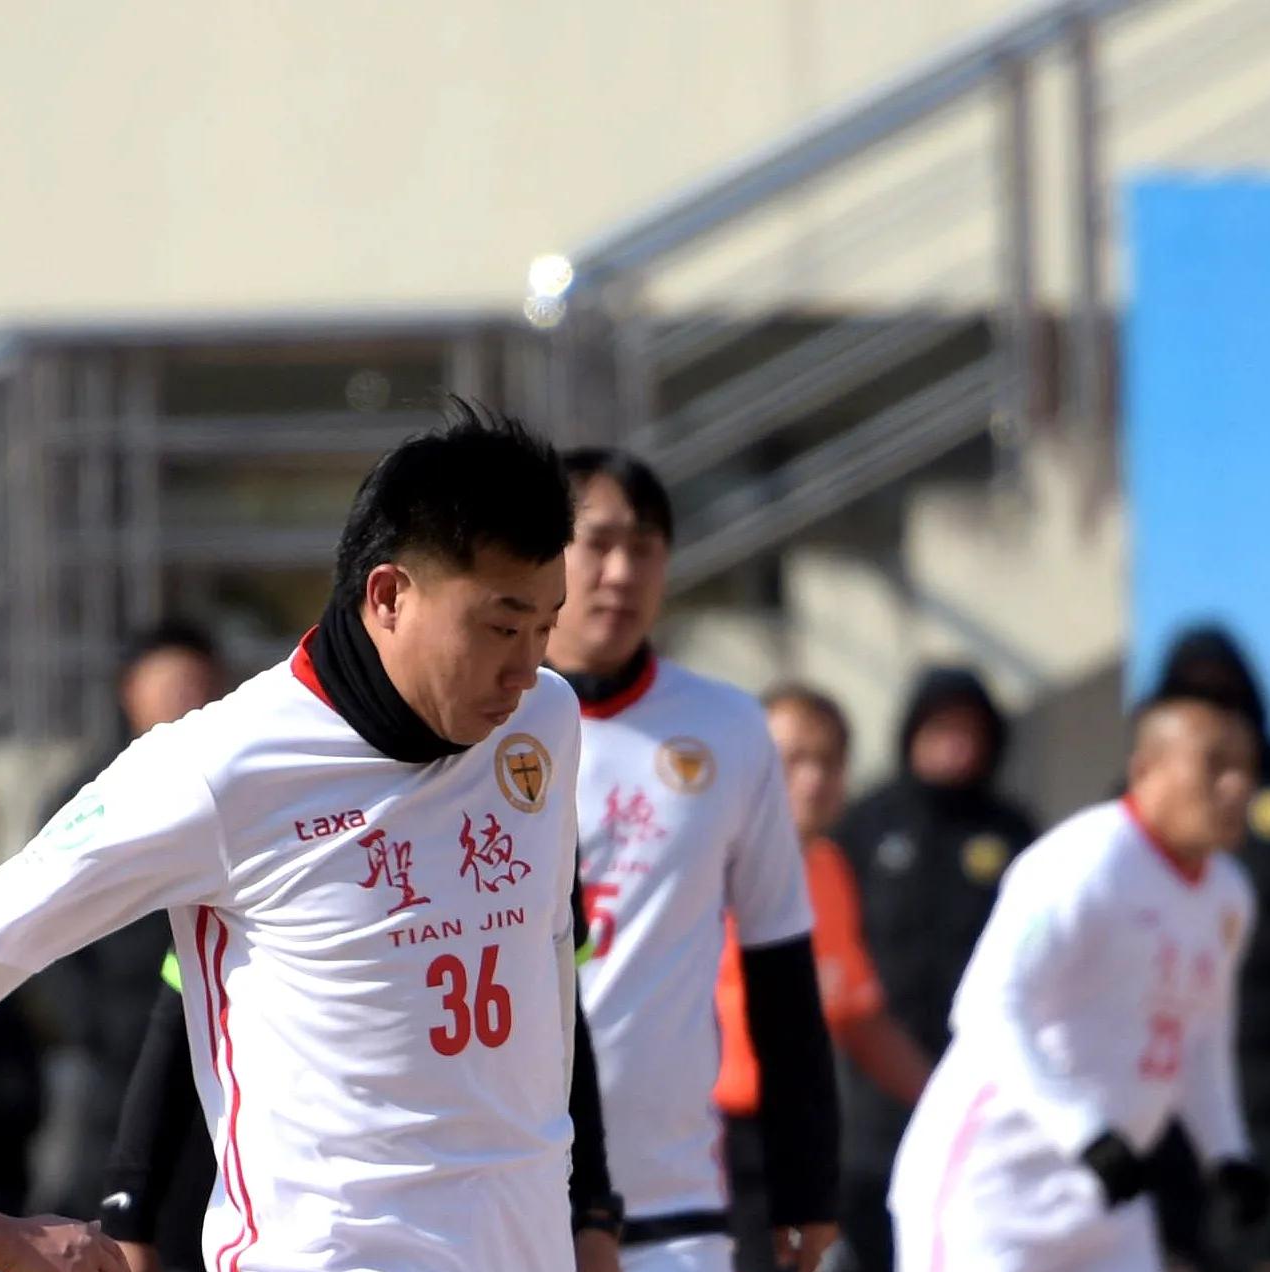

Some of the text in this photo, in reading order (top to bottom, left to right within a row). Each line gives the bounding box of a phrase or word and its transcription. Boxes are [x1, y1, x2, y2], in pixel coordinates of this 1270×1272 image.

[294, 808, 367, 841] taxa
[387, 905, 526, 948] TIAN JIN
[425, 944, 513, 1057] 36
